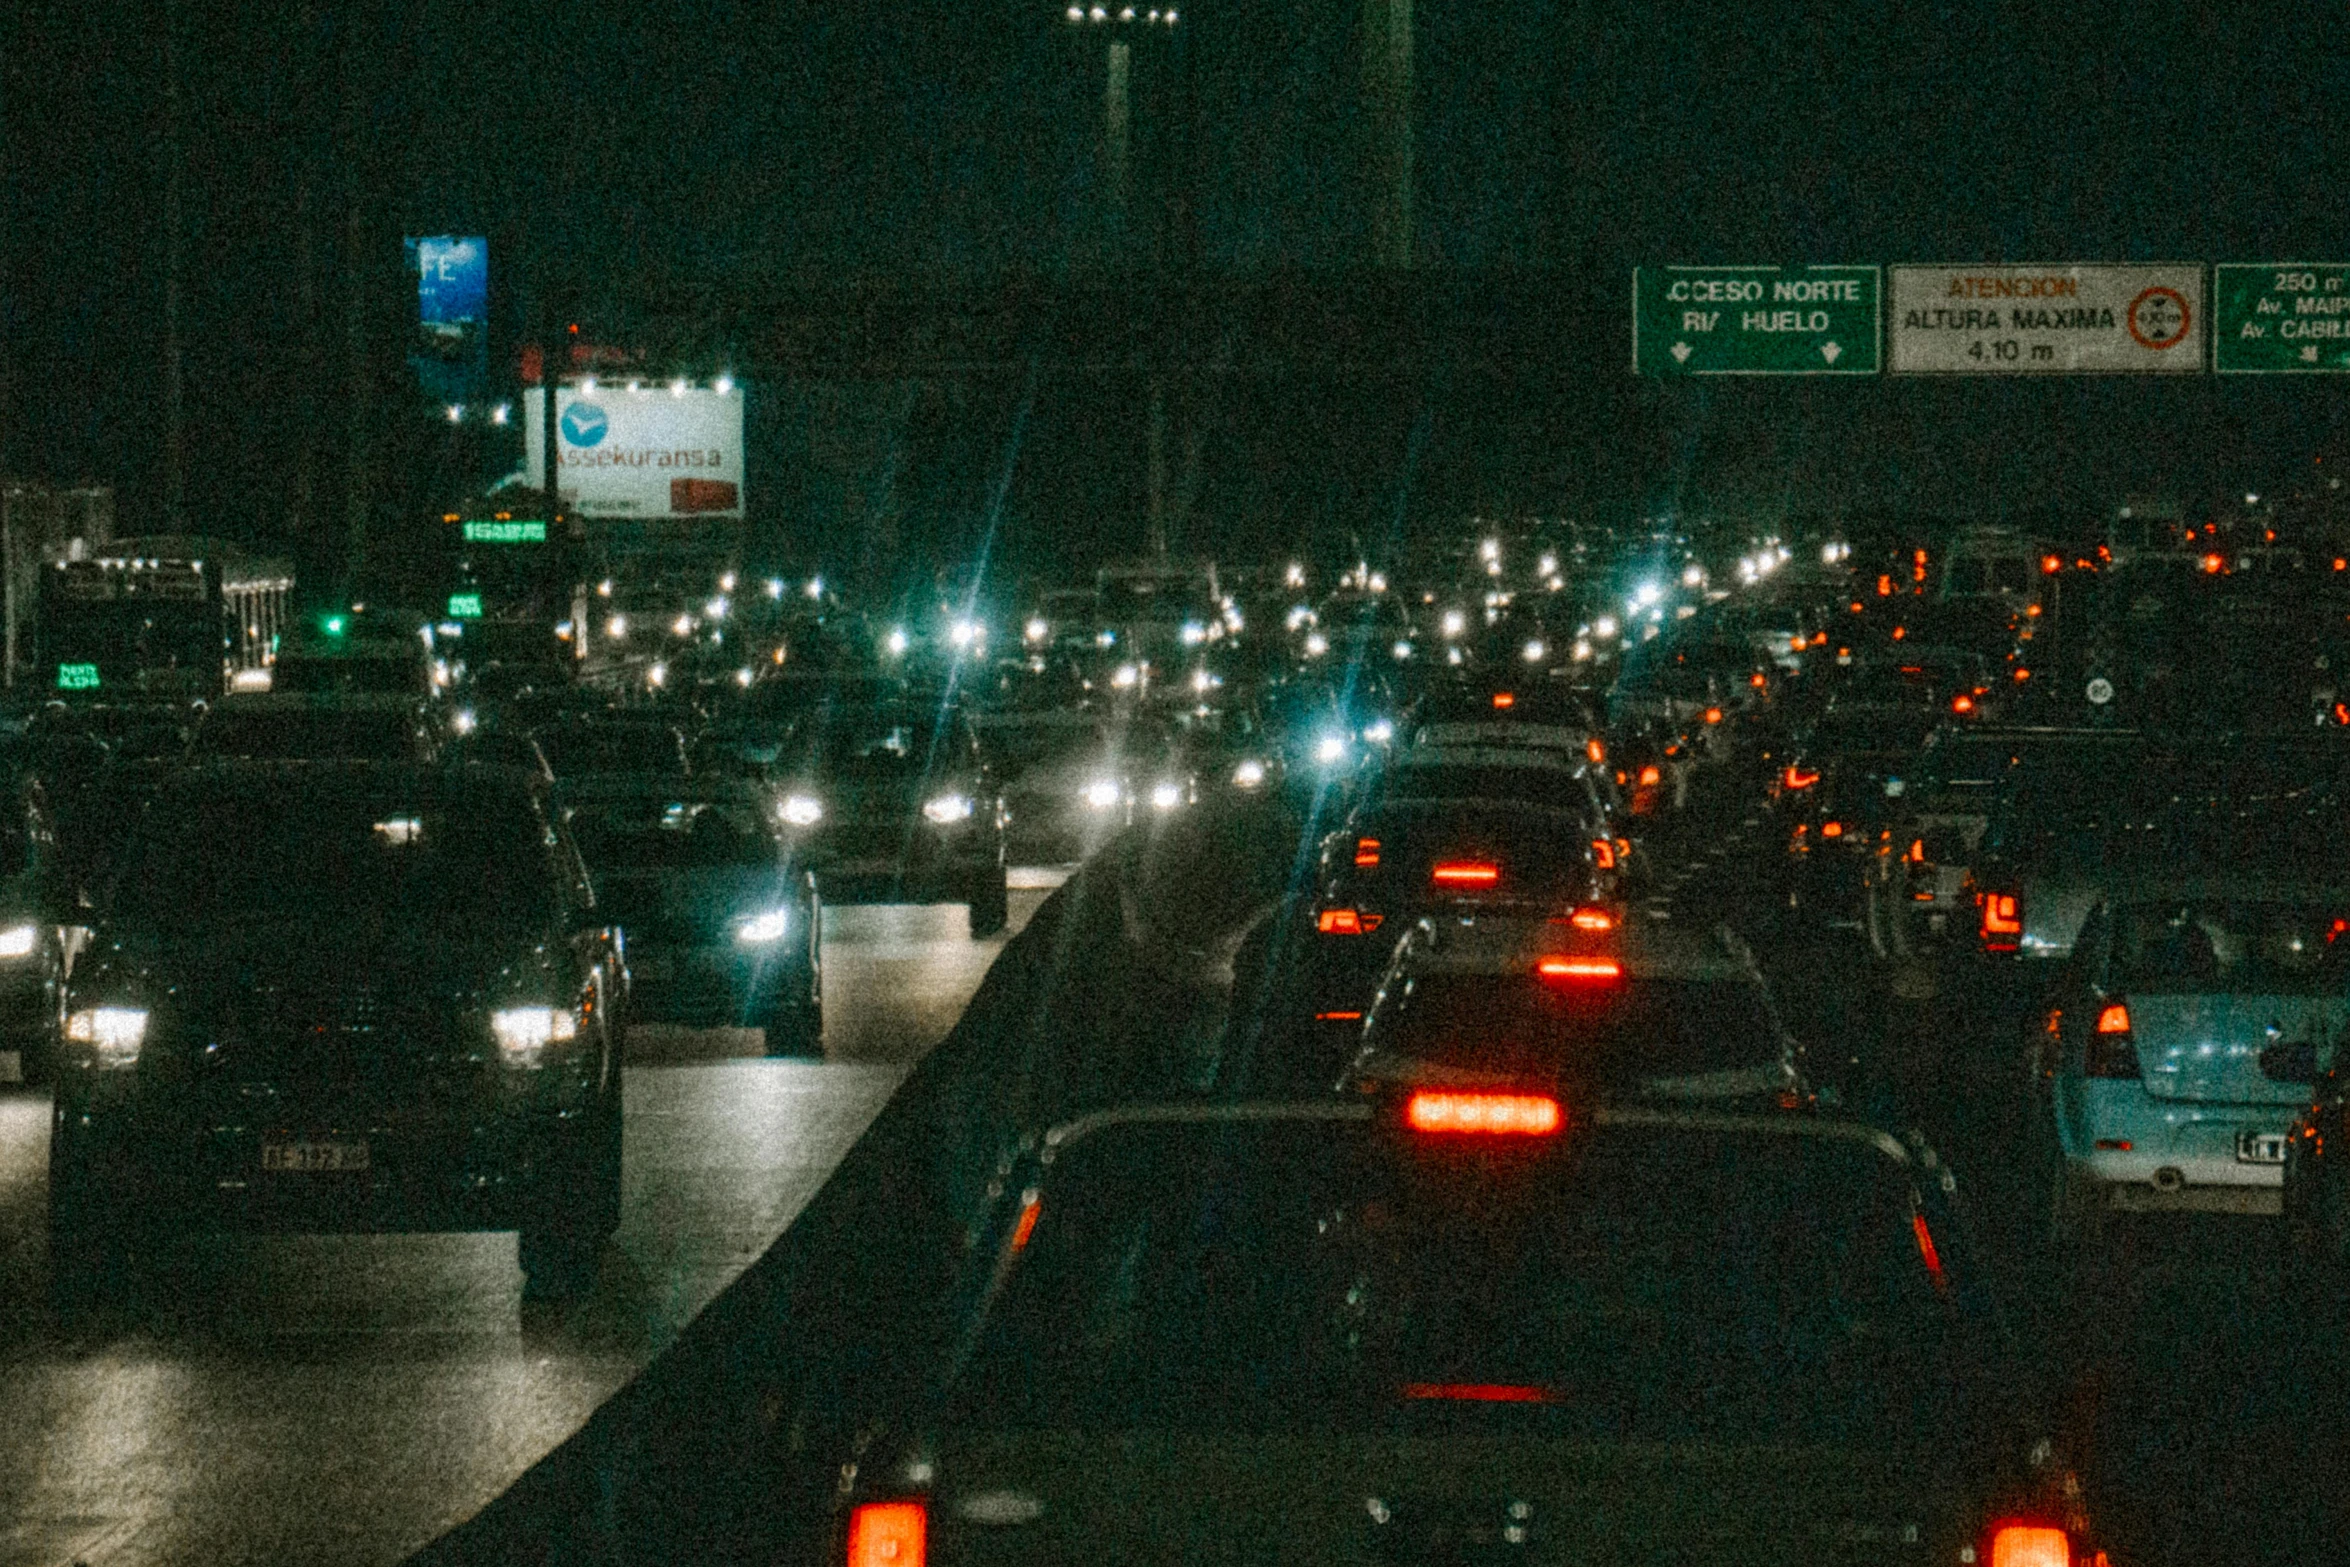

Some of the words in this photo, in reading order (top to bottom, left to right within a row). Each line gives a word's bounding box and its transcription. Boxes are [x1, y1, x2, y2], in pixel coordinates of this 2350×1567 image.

[1666, 280, 1764, 302] CCESO
[1773, 280, 1861, 301] NORTE
[1948, 276, 2078, 298] ATENCION
[2274, 272, 2317, 292] 250
[1904, 308, 2001, 330] ALTURA
[2012, 308, 2118, 330] MAXIMA
[2031, 343, 2055, 361] m
